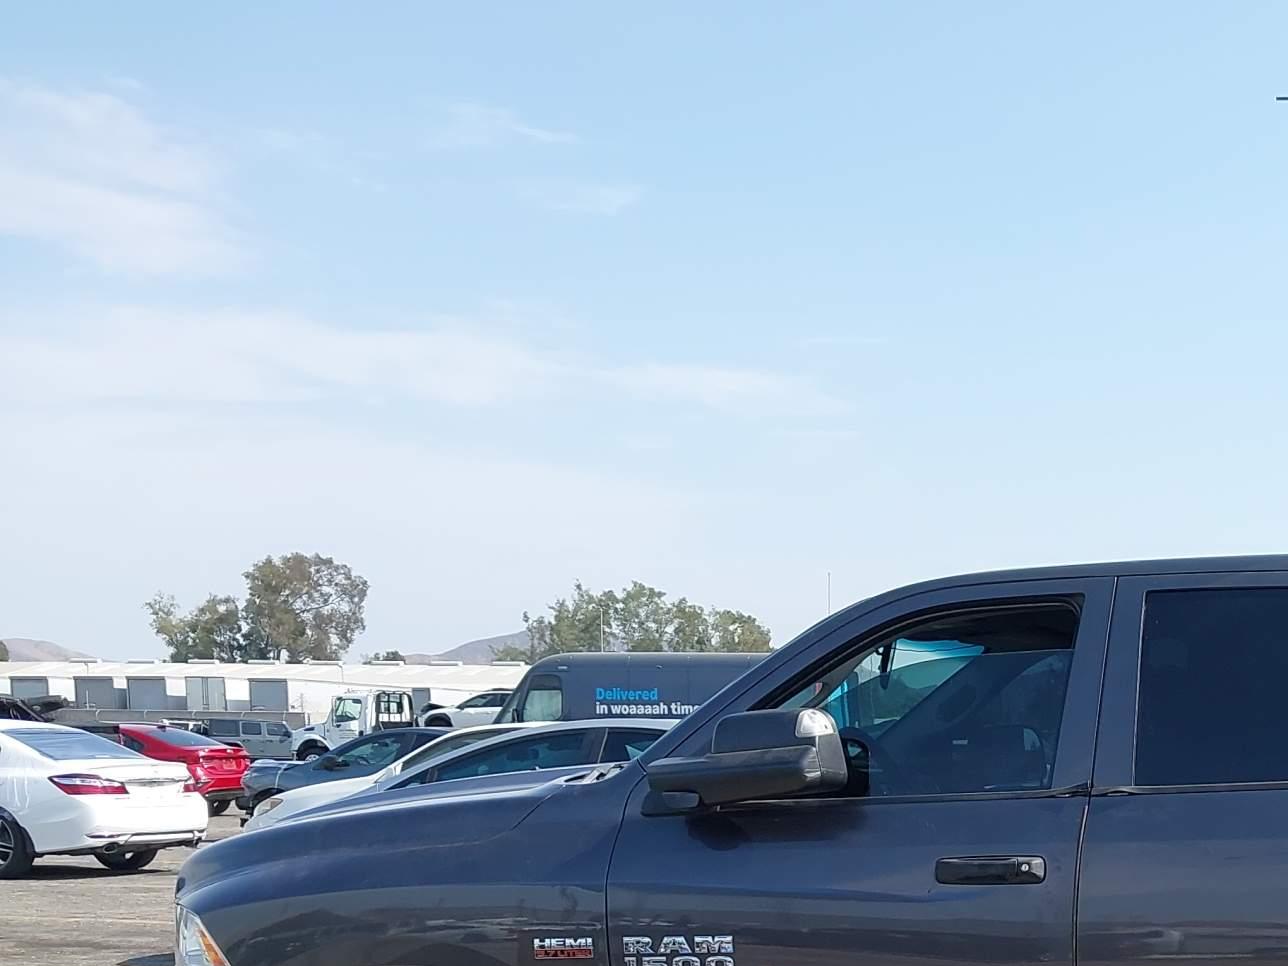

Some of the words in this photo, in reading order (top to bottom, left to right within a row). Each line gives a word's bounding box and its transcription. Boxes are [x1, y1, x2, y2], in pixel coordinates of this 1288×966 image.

[595, 687, 658, 700] Delivered
[595, 701, 609, 715] in
[610, 701, 669, 715] woaaaah
[533, 937, 593, 949] HEMI
[622, 935, 735, 954] RAM
